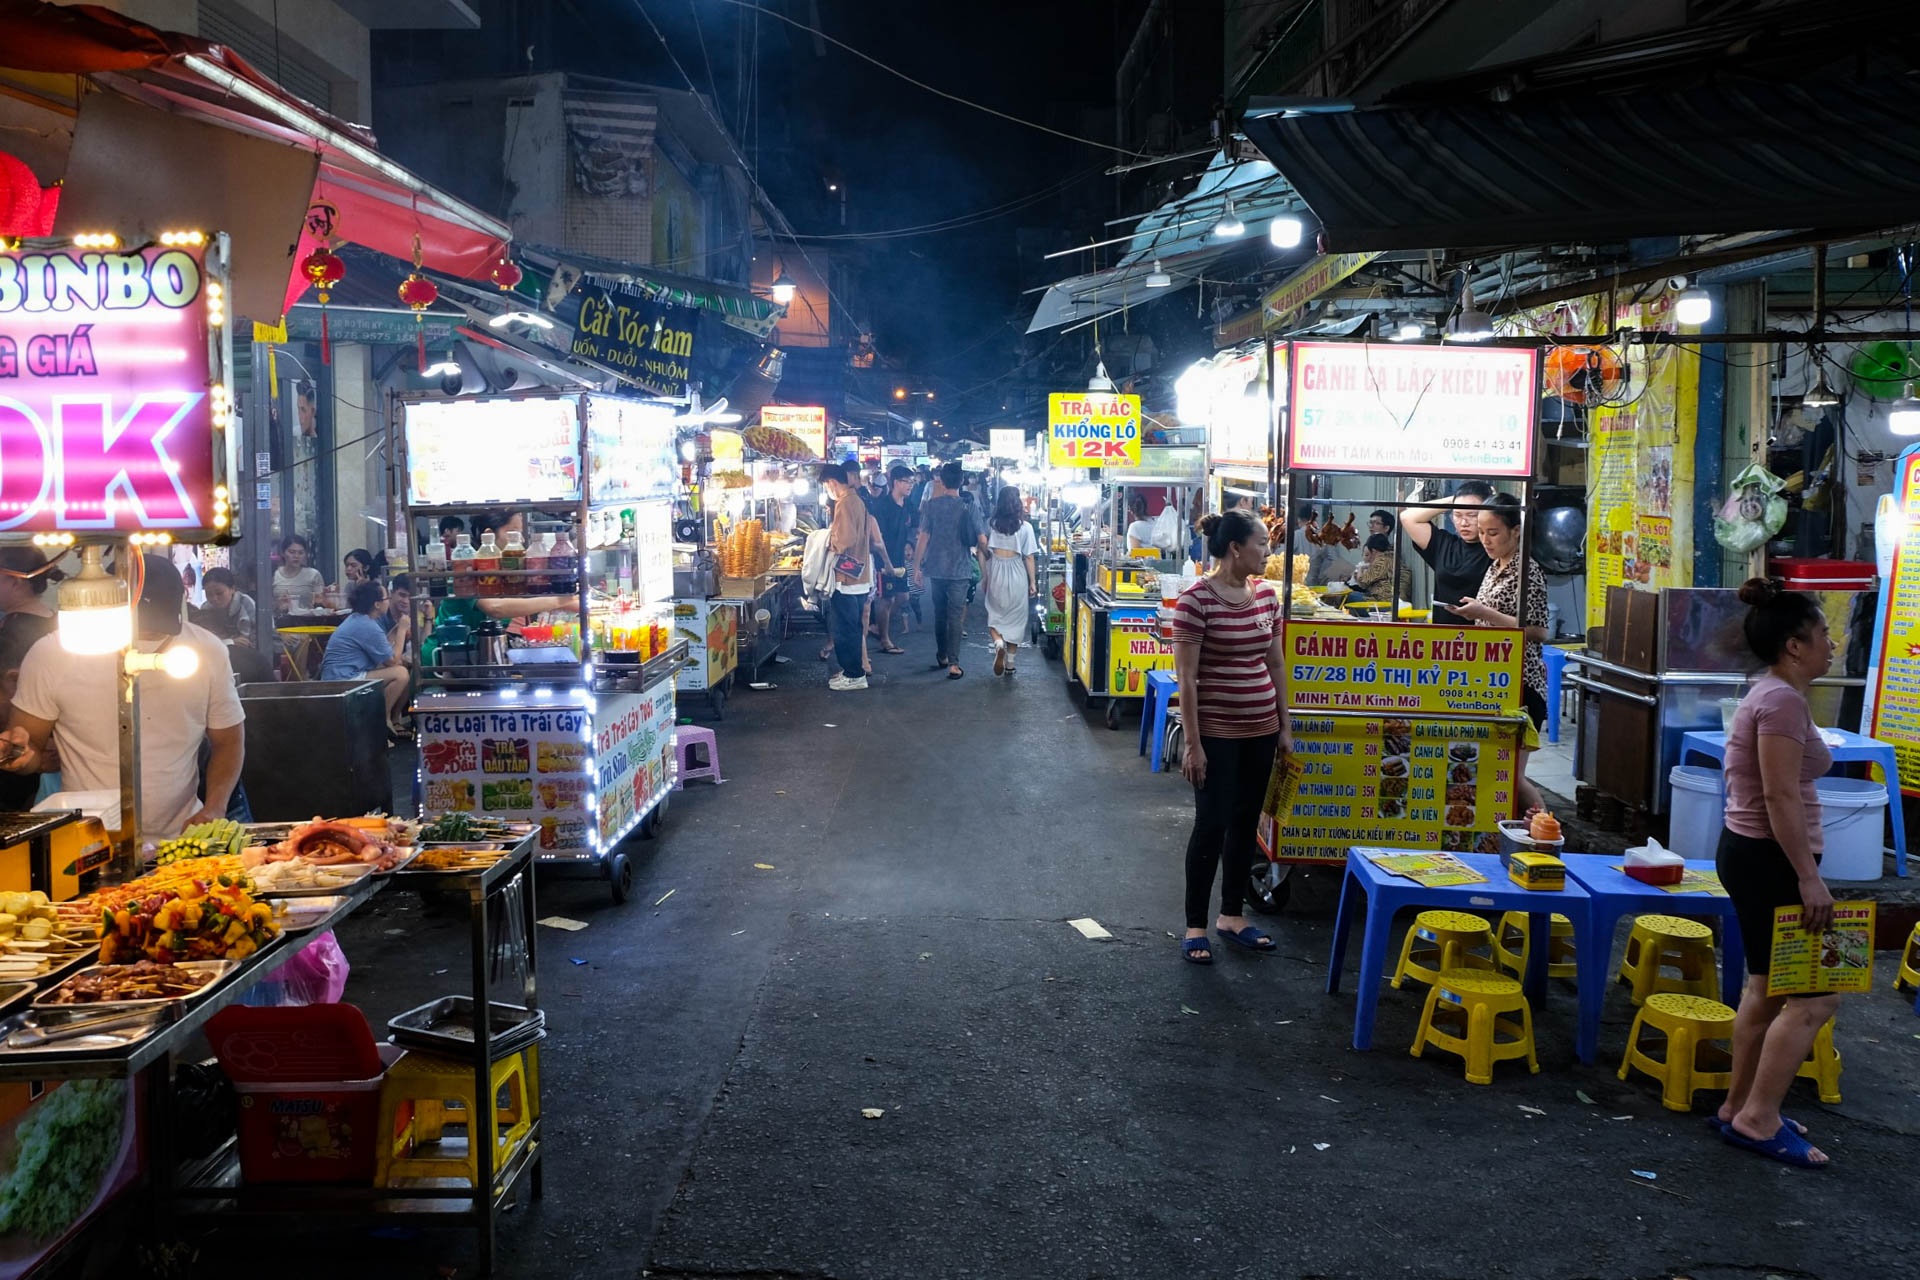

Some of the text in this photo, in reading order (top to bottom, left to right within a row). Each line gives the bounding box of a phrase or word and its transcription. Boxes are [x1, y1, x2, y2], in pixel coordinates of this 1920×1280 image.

[617, 306, 650, 348] Tóc
[27, 323, 98, 377] GIÁ
[645, 359, 688, 381] NHUỘM
[1061, 397, 1131, 416] TRÀ TẮC
[1054, 418, 1136, 439] KHỔNG LỒ
[1062, 441, 1128, 457] 12K
[1300, 444, 1336, 459] MINH
[1508, 440, 1522, 450] 41
[1130, 641, 1156, 654] NHA
[1294, 630, 1514, 663] CÁNH GÀ LẮC KIỂU MỸ
[1293, 665, 1347, 682] 57/28
[1352, 662, 1377, 683] HỒ
[1382, 667, 1412, 688] THỊ
[1417, 664, 1442, 686] KỶ
[1447, 670, 1469, 686] P1
[1488, 672, 1510, 688] 10
[1295, 691, 1421, 708] MINH TÂM Kính Mời
[1439, 689, 1509, 700] 0908 41 43 41
[1446, 700, 1501, 710] VietinBank
[424, 713, 583, 737] Các Loại Trà Trái Cây
[1365, 722, 1379, 735] 50K
[1415, 721, 1424, 736] GÀ
[1427, 722, 1443, 737] VIÊN
[597, 723, 611, 757] Trà
[611, 715, 627, 742] Trái
[1307, 741, 1321, 754] NON
[1323, 742, 1341, 756] QUAY
[1365, 744, 1379, 756] 50K
[1414, 743, 1444, 758] CÁNH GÀ
[1497, 749, 1510, 760] 30K
[1363, 764, 1376, 776] 35K
[1424, 764, 1434, 779] GÀ
[1496, 769, 1509, 781] 30K
[1336, 785, 1344, 796] 10
[1362, 785, 1376, 797] 35K
[1425, 785, 1435, 800] GÀ
[1494, 791, 1508, 803] 30K
[1318, 801, 1340, 817] CHIÊN
[1361, 806, 1374, 818] 25K
[1410, 806, 1438, 821] GÀ VIÊN
[1281, 825, 1300, 838] CHÂN
[1301, 826, 1311, 838] GÀ
[1385, 827, 1396, 841] MỸ
[1397, 831, 1403, 840] 5
[1425, 832, 1439, 843] 35K
[270, 1097, 324, 1113] MATSU
